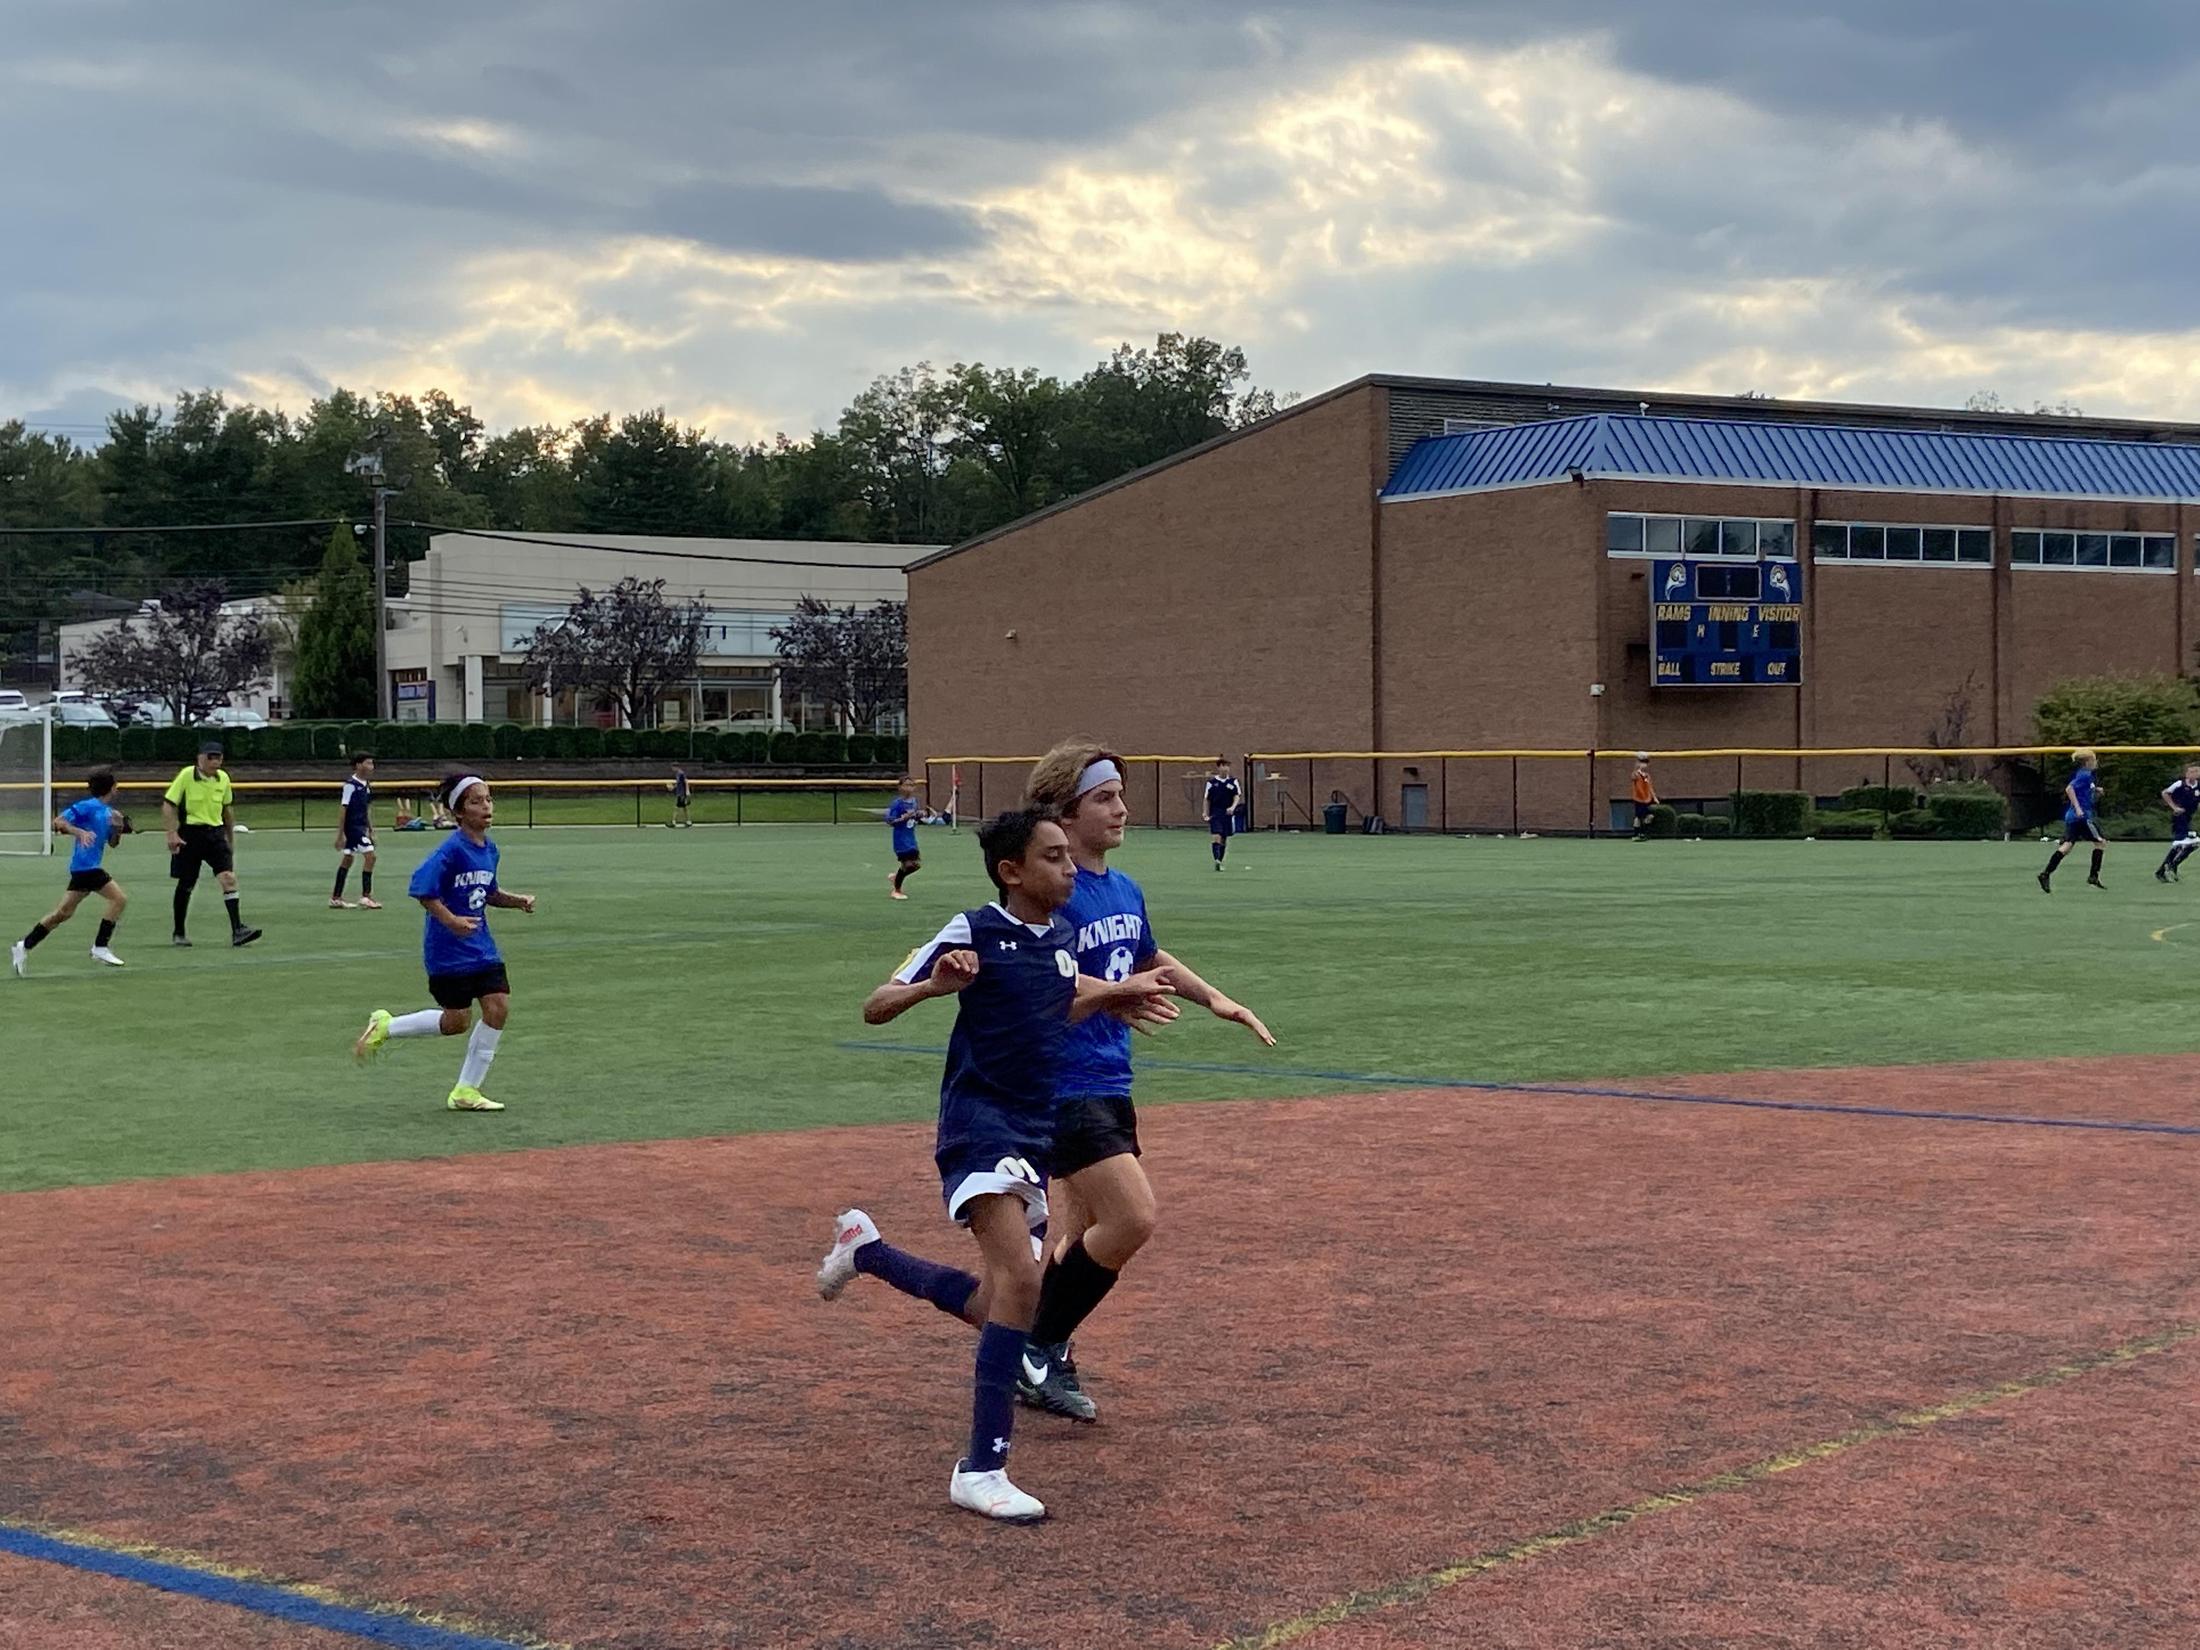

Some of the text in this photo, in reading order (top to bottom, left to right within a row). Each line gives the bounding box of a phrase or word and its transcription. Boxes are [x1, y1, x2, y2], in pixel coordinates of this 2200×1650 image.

[1657, 605, 1800, 622] RAMS INNING VISITOR
[1658, 662, 1681, 676] BALL
[1710, 662, 1741, 676] STRIKE
